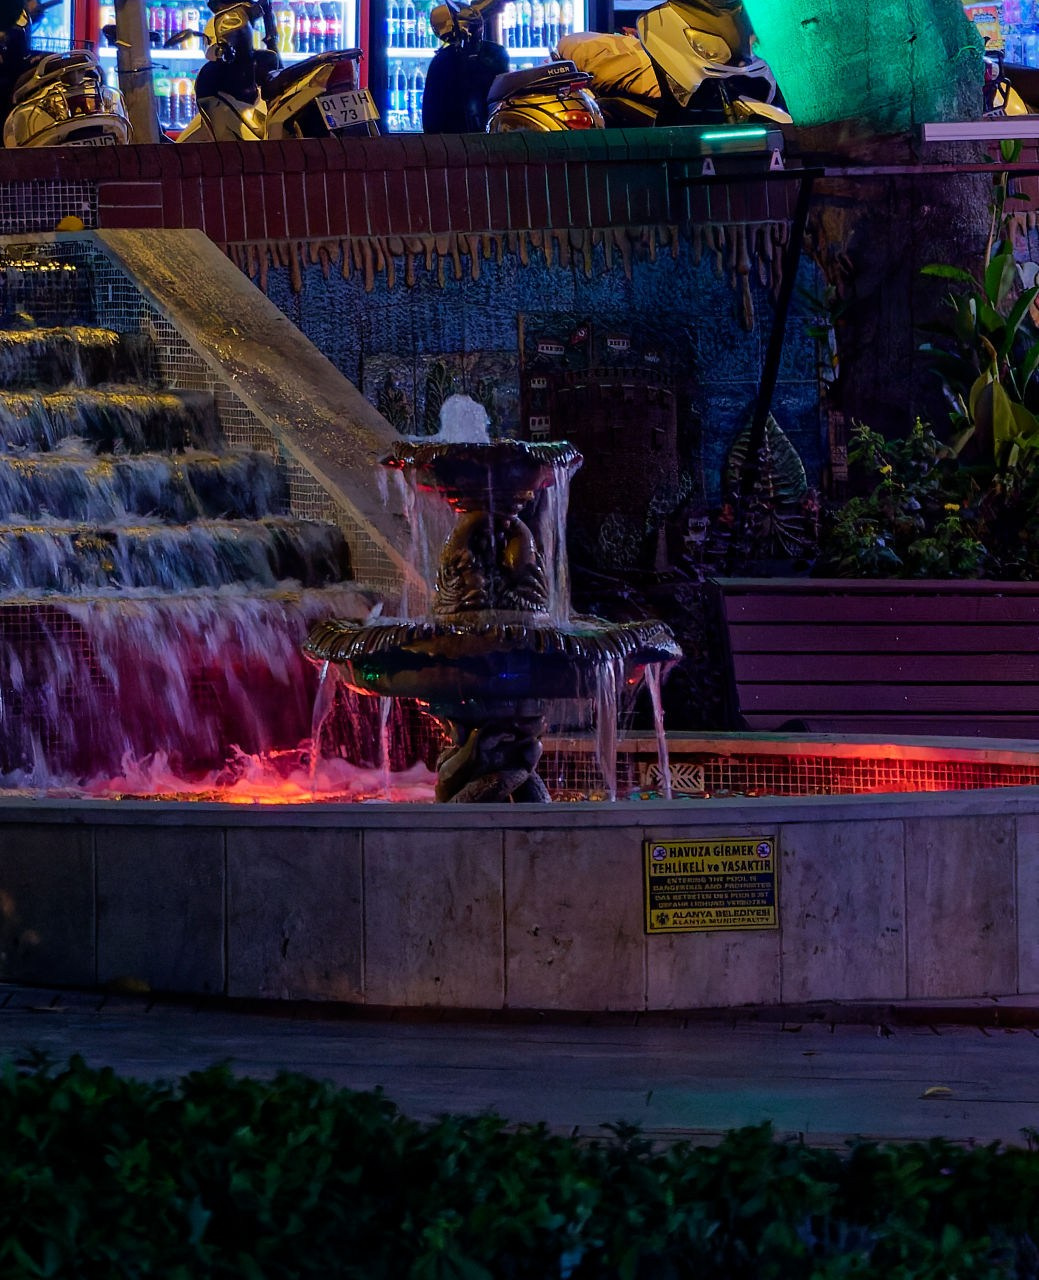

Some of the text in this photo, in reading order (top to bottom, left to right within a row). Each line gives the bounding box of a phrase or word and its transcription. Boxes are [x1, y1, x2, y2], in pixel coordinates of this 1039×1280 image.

[321, 100, 337, 112] 01
[340, 109, 358, 122] 73
[669, 844, 754, 858] HAVUZA GİRMEK
[652, 860, 771, 874] TEHLİKELİ ve YASAKTIR
[672, 910, 713, 919] ALANYA
